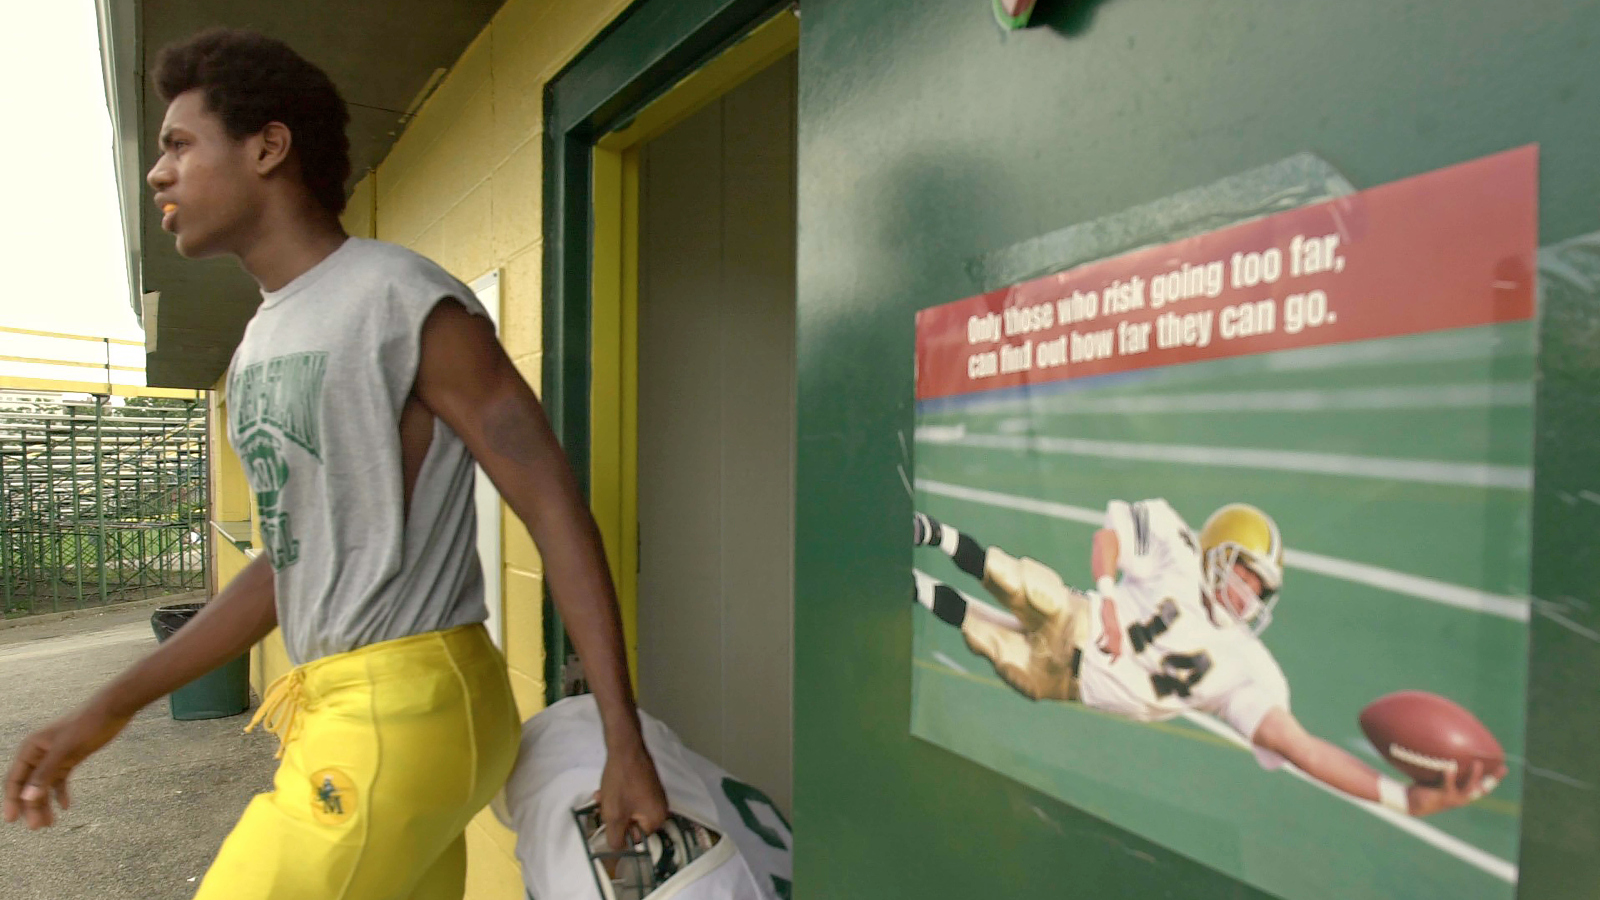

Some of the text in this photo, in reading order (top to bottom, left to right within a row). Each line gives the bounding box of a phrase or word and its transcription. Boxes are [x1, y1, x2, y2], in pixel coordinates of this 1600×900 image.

[967, 233, 1346, 345] Only those who risk going too far,
[967, 290, 1338, 380] can find out how far they can go.
